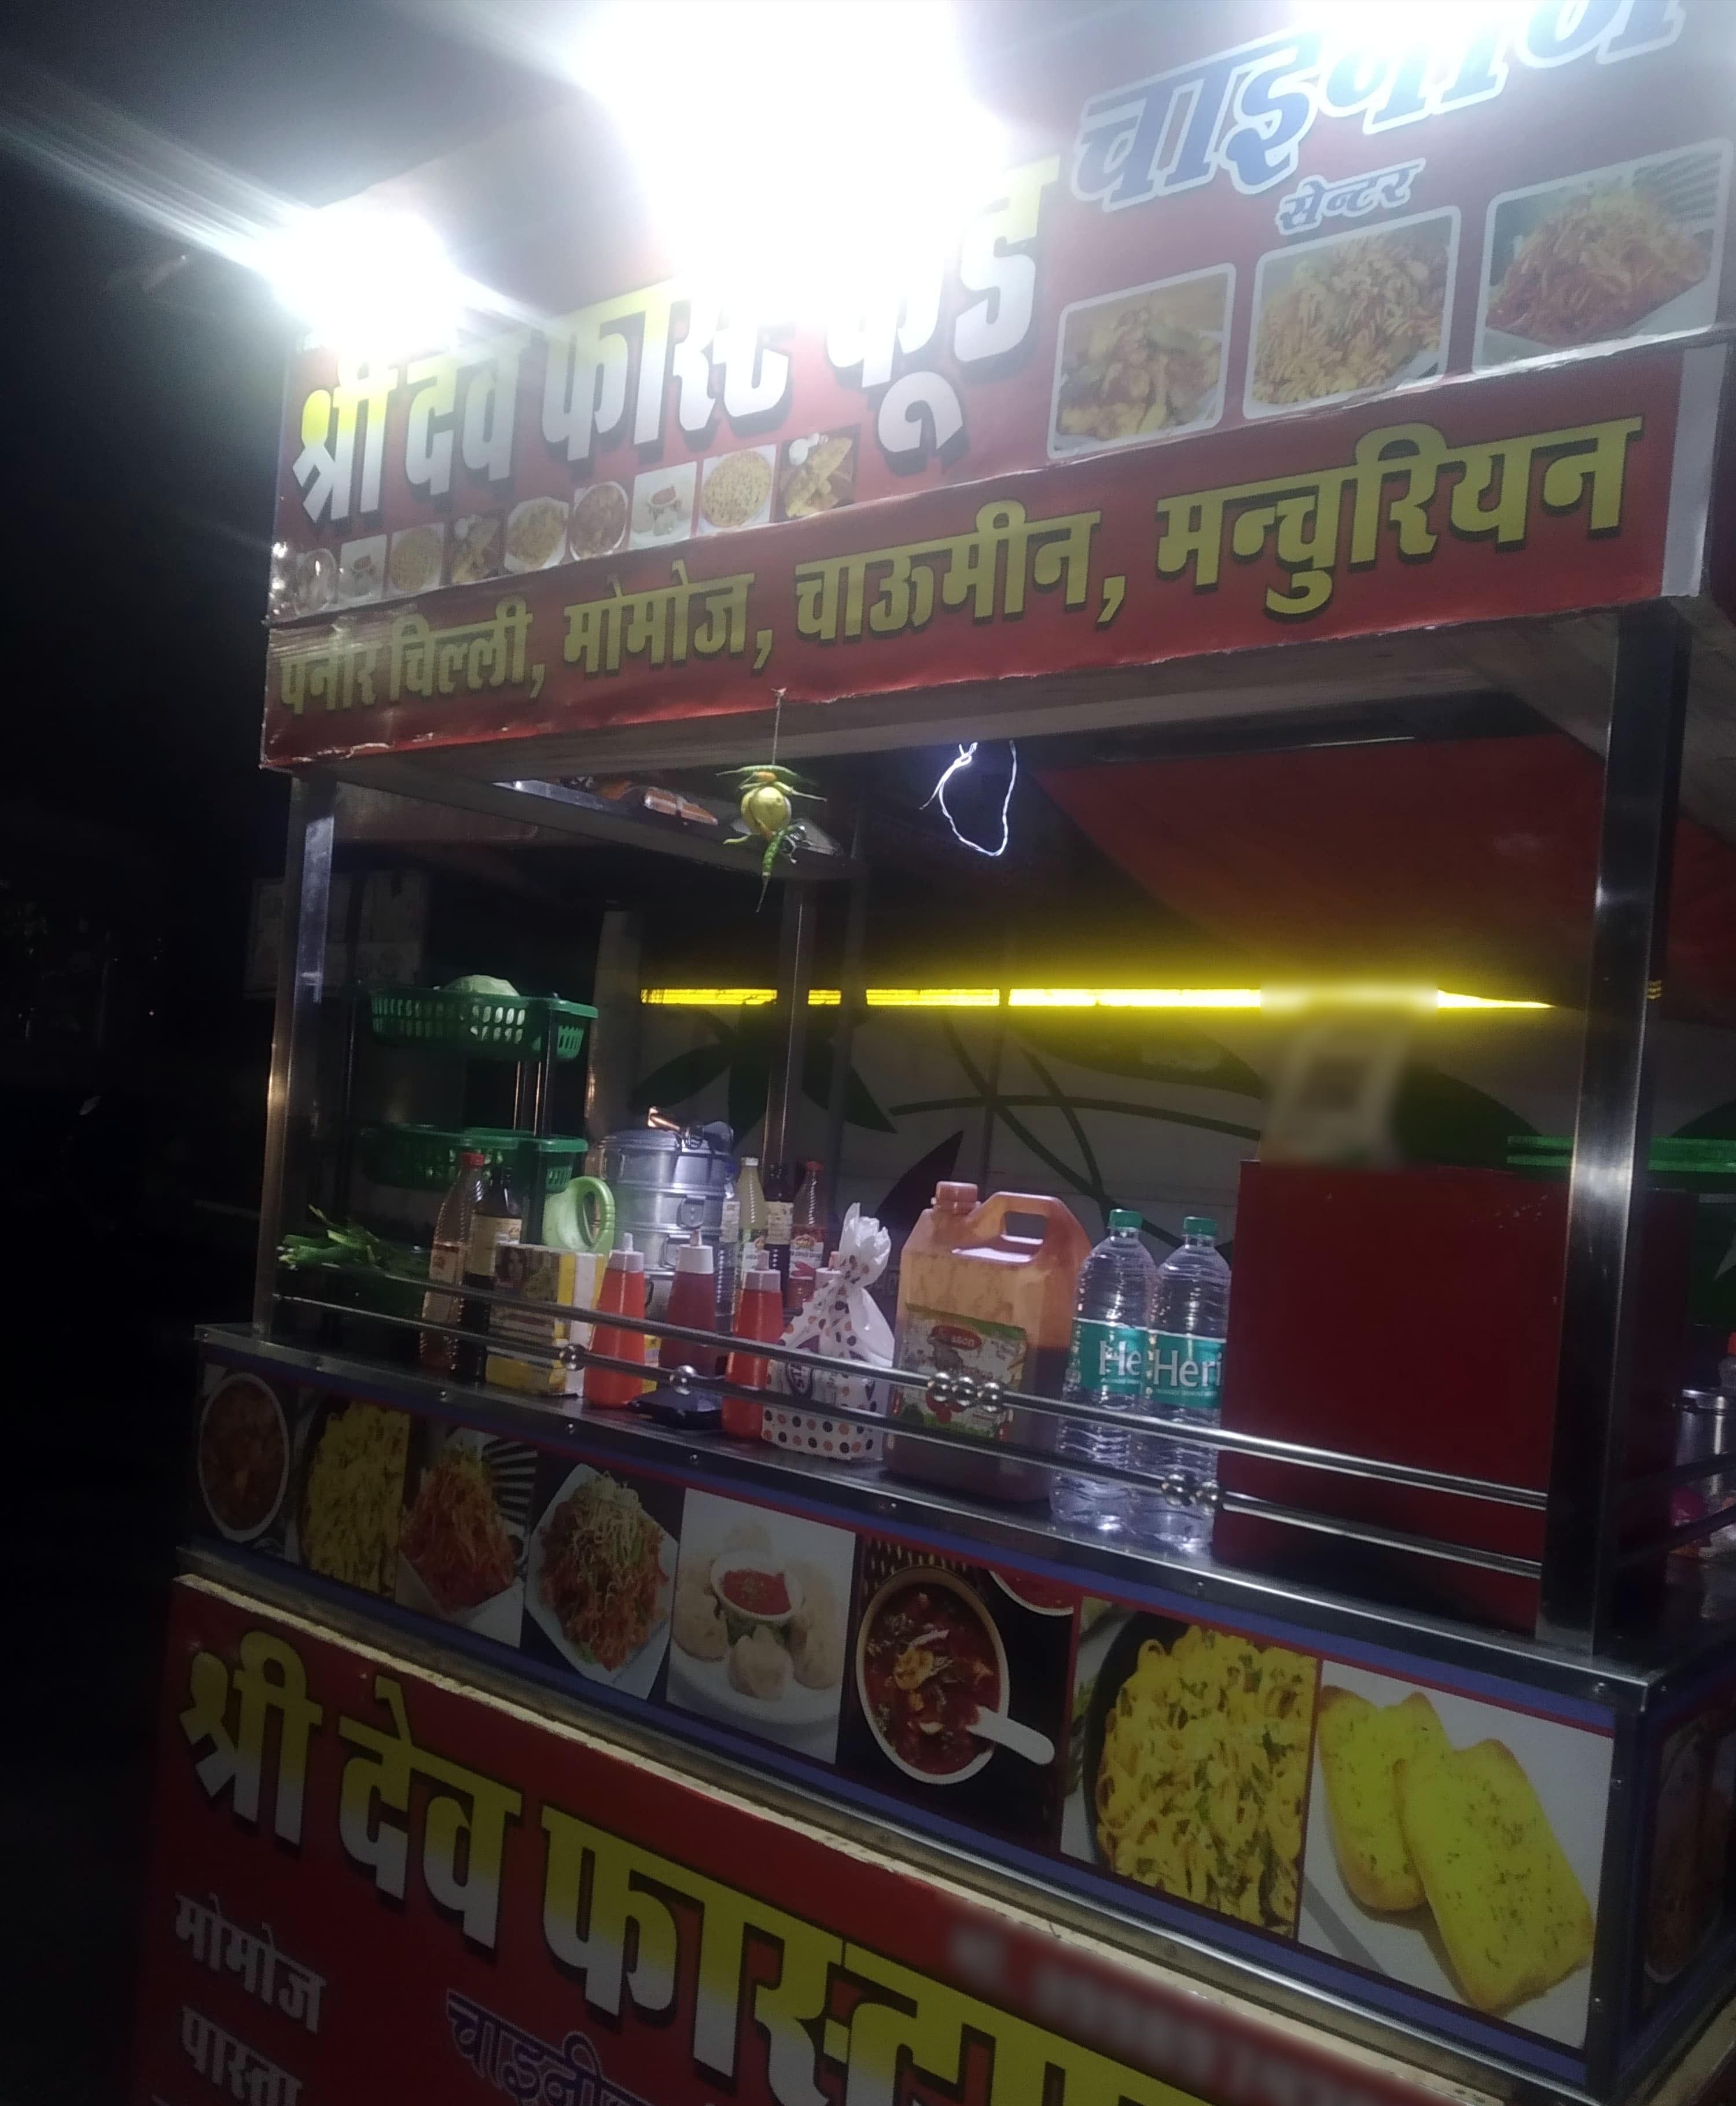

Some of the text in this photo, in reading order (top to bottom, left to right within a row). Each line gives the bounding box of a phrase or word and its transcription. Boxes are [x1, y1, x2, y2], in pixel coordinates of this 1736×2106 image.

[404, 324, 534, 496] दव
[795, 498, 1126, 641] चाऊमीन,
[1156, 422, 1643, 616] मन्चुरियन
[179, 1629, 323, 1847] श्री
[338, 1674, 523, 1951] देव
[174, 1891, 328, 2035] मोमोज
[445, 1987, 657, 2106] चाइनी
